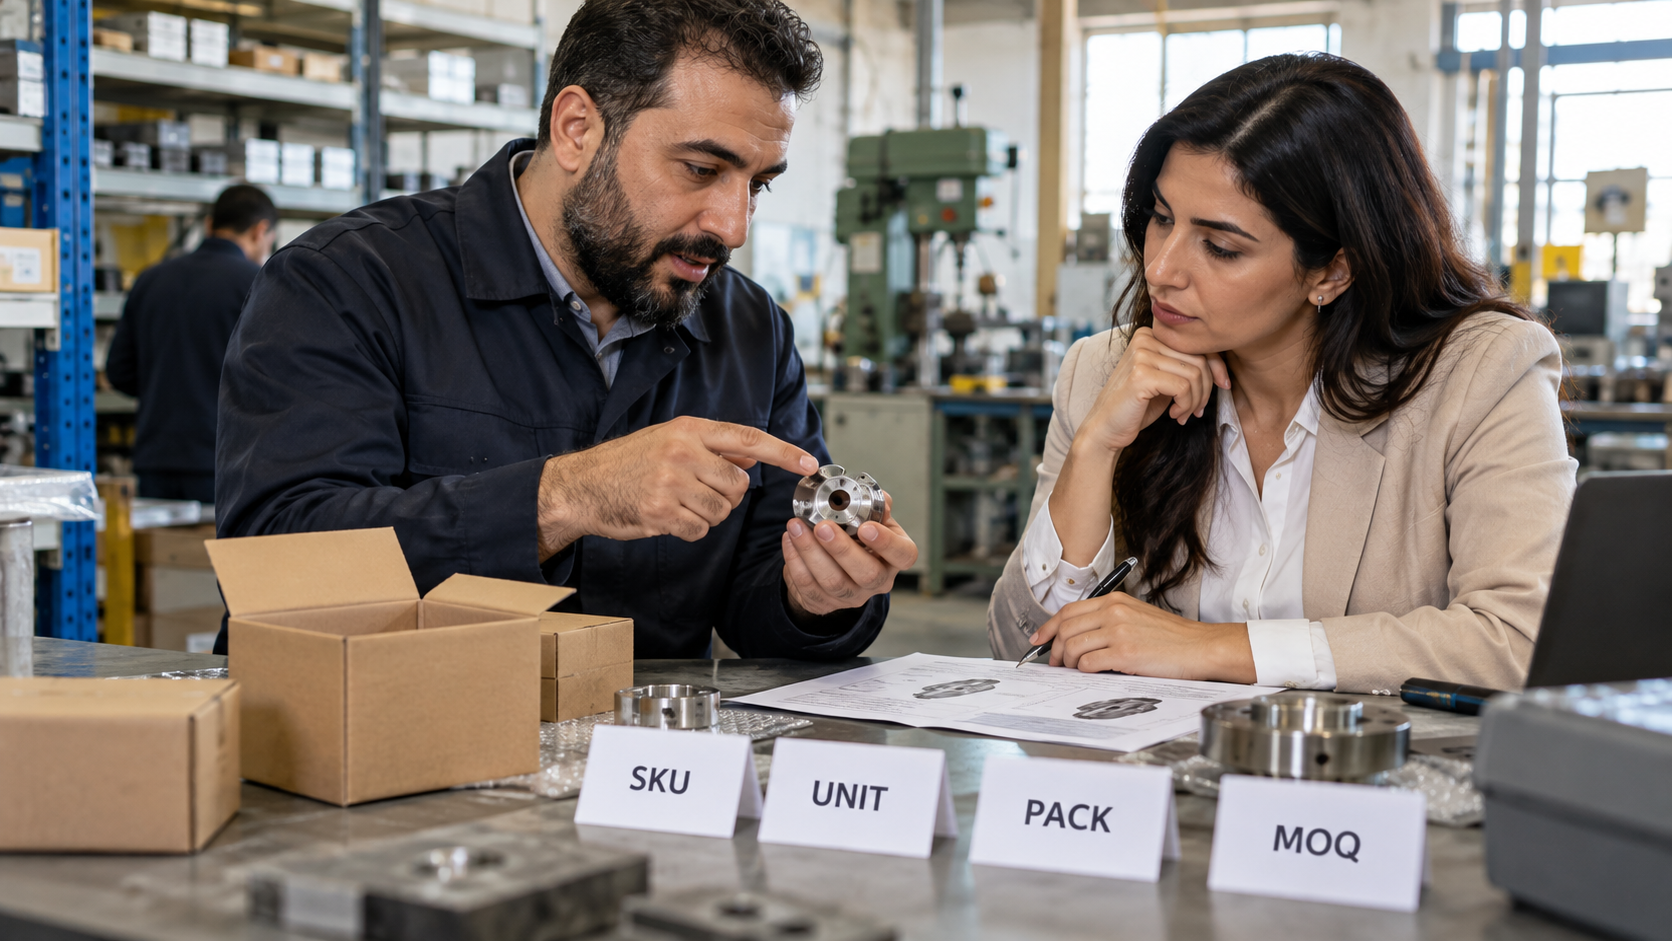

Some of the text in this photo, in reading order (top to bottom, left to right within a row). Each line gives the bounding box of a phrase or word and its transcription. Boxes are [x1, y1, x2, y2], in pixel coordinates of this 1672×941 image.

[629, 765, 691, 795] SKU
[812, 780, 889, 812] UNIT
[1024, 799, 1113, 833] PACK
[1273, 824, 1361, 864] MOQ
